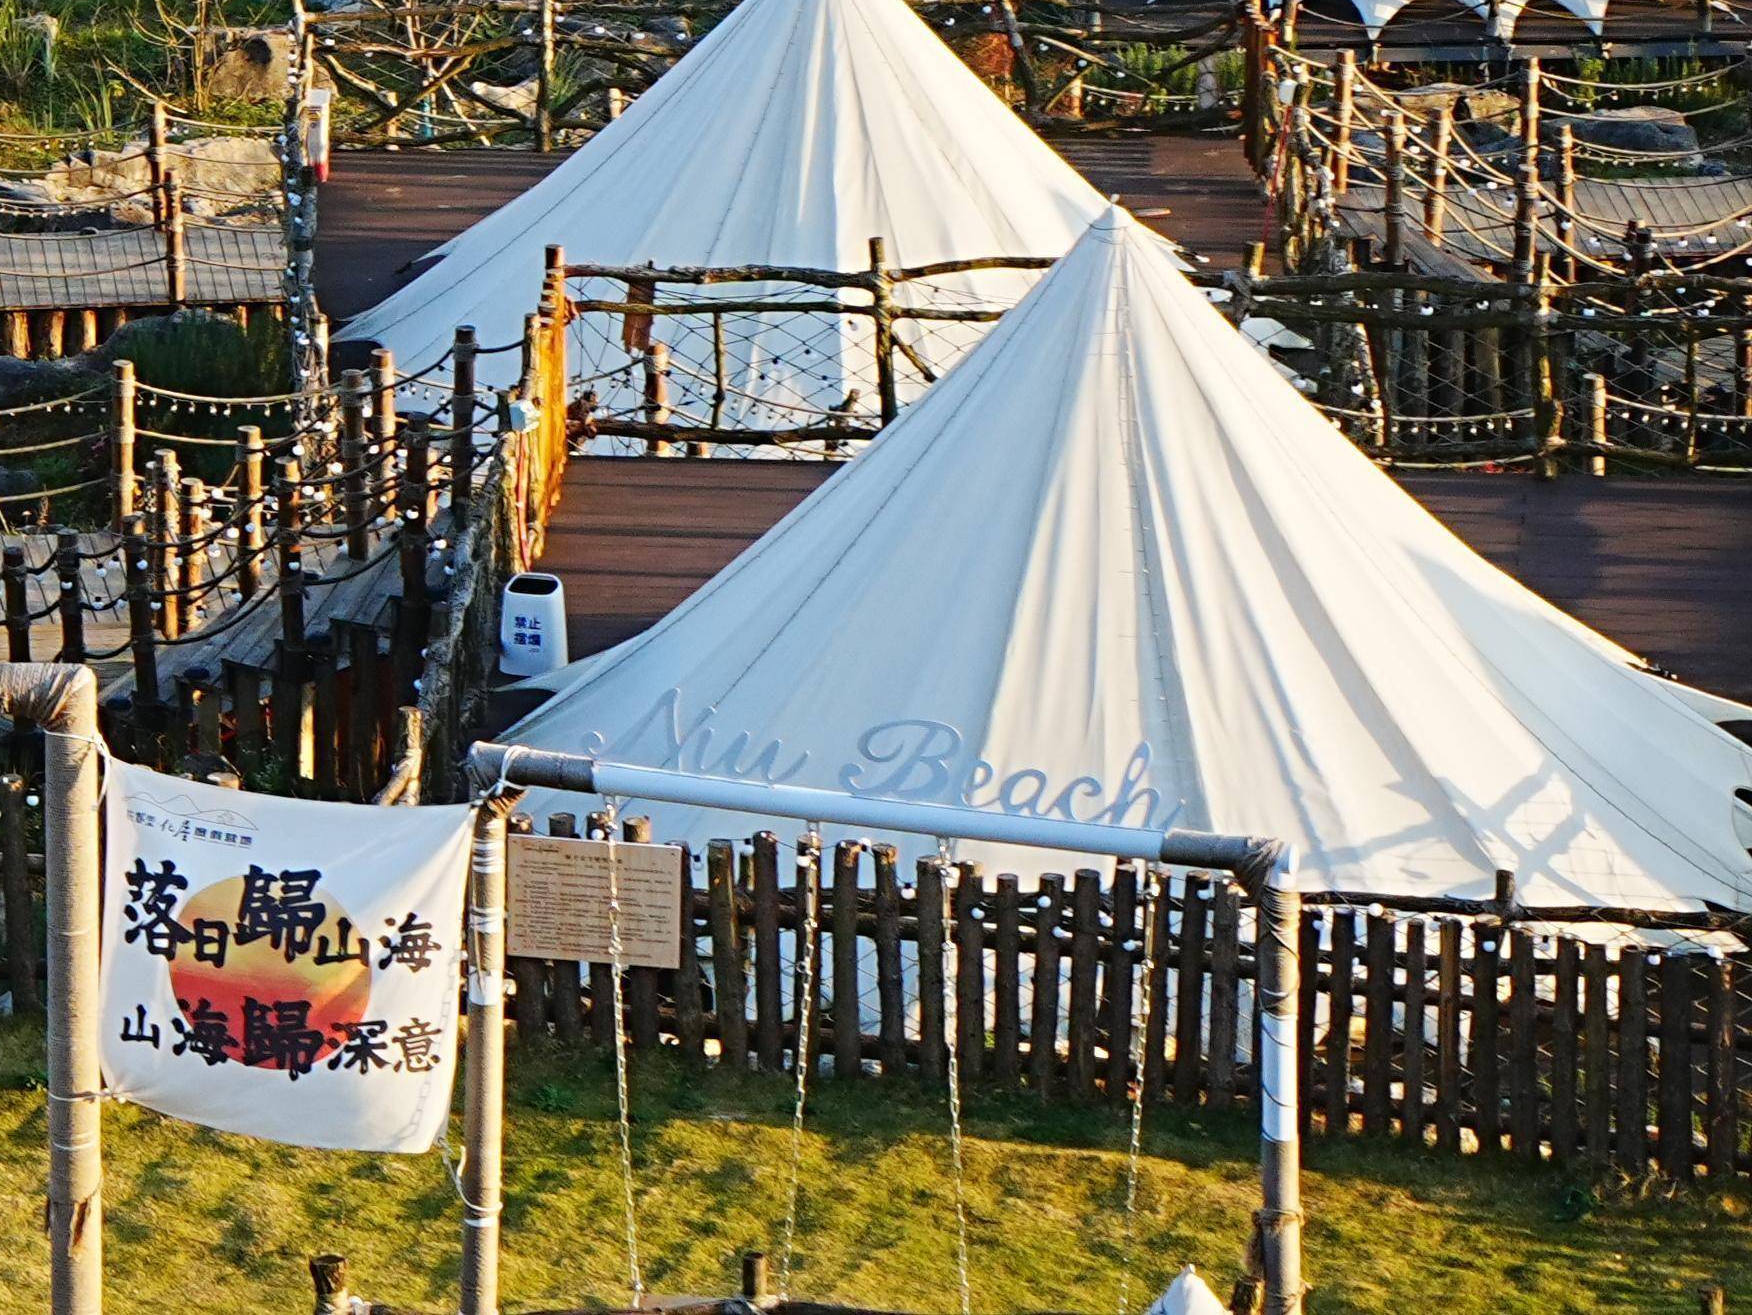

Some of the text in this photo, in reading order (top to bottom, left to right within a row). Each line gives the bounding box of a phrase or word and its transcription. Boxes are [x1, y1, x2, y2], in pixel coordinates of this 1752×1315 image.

[839, 719, 1184, 832] Beach
[122, 858, 443, 973] 落日歸山海
[119, 996, 445, 1082] 山海歸深意
